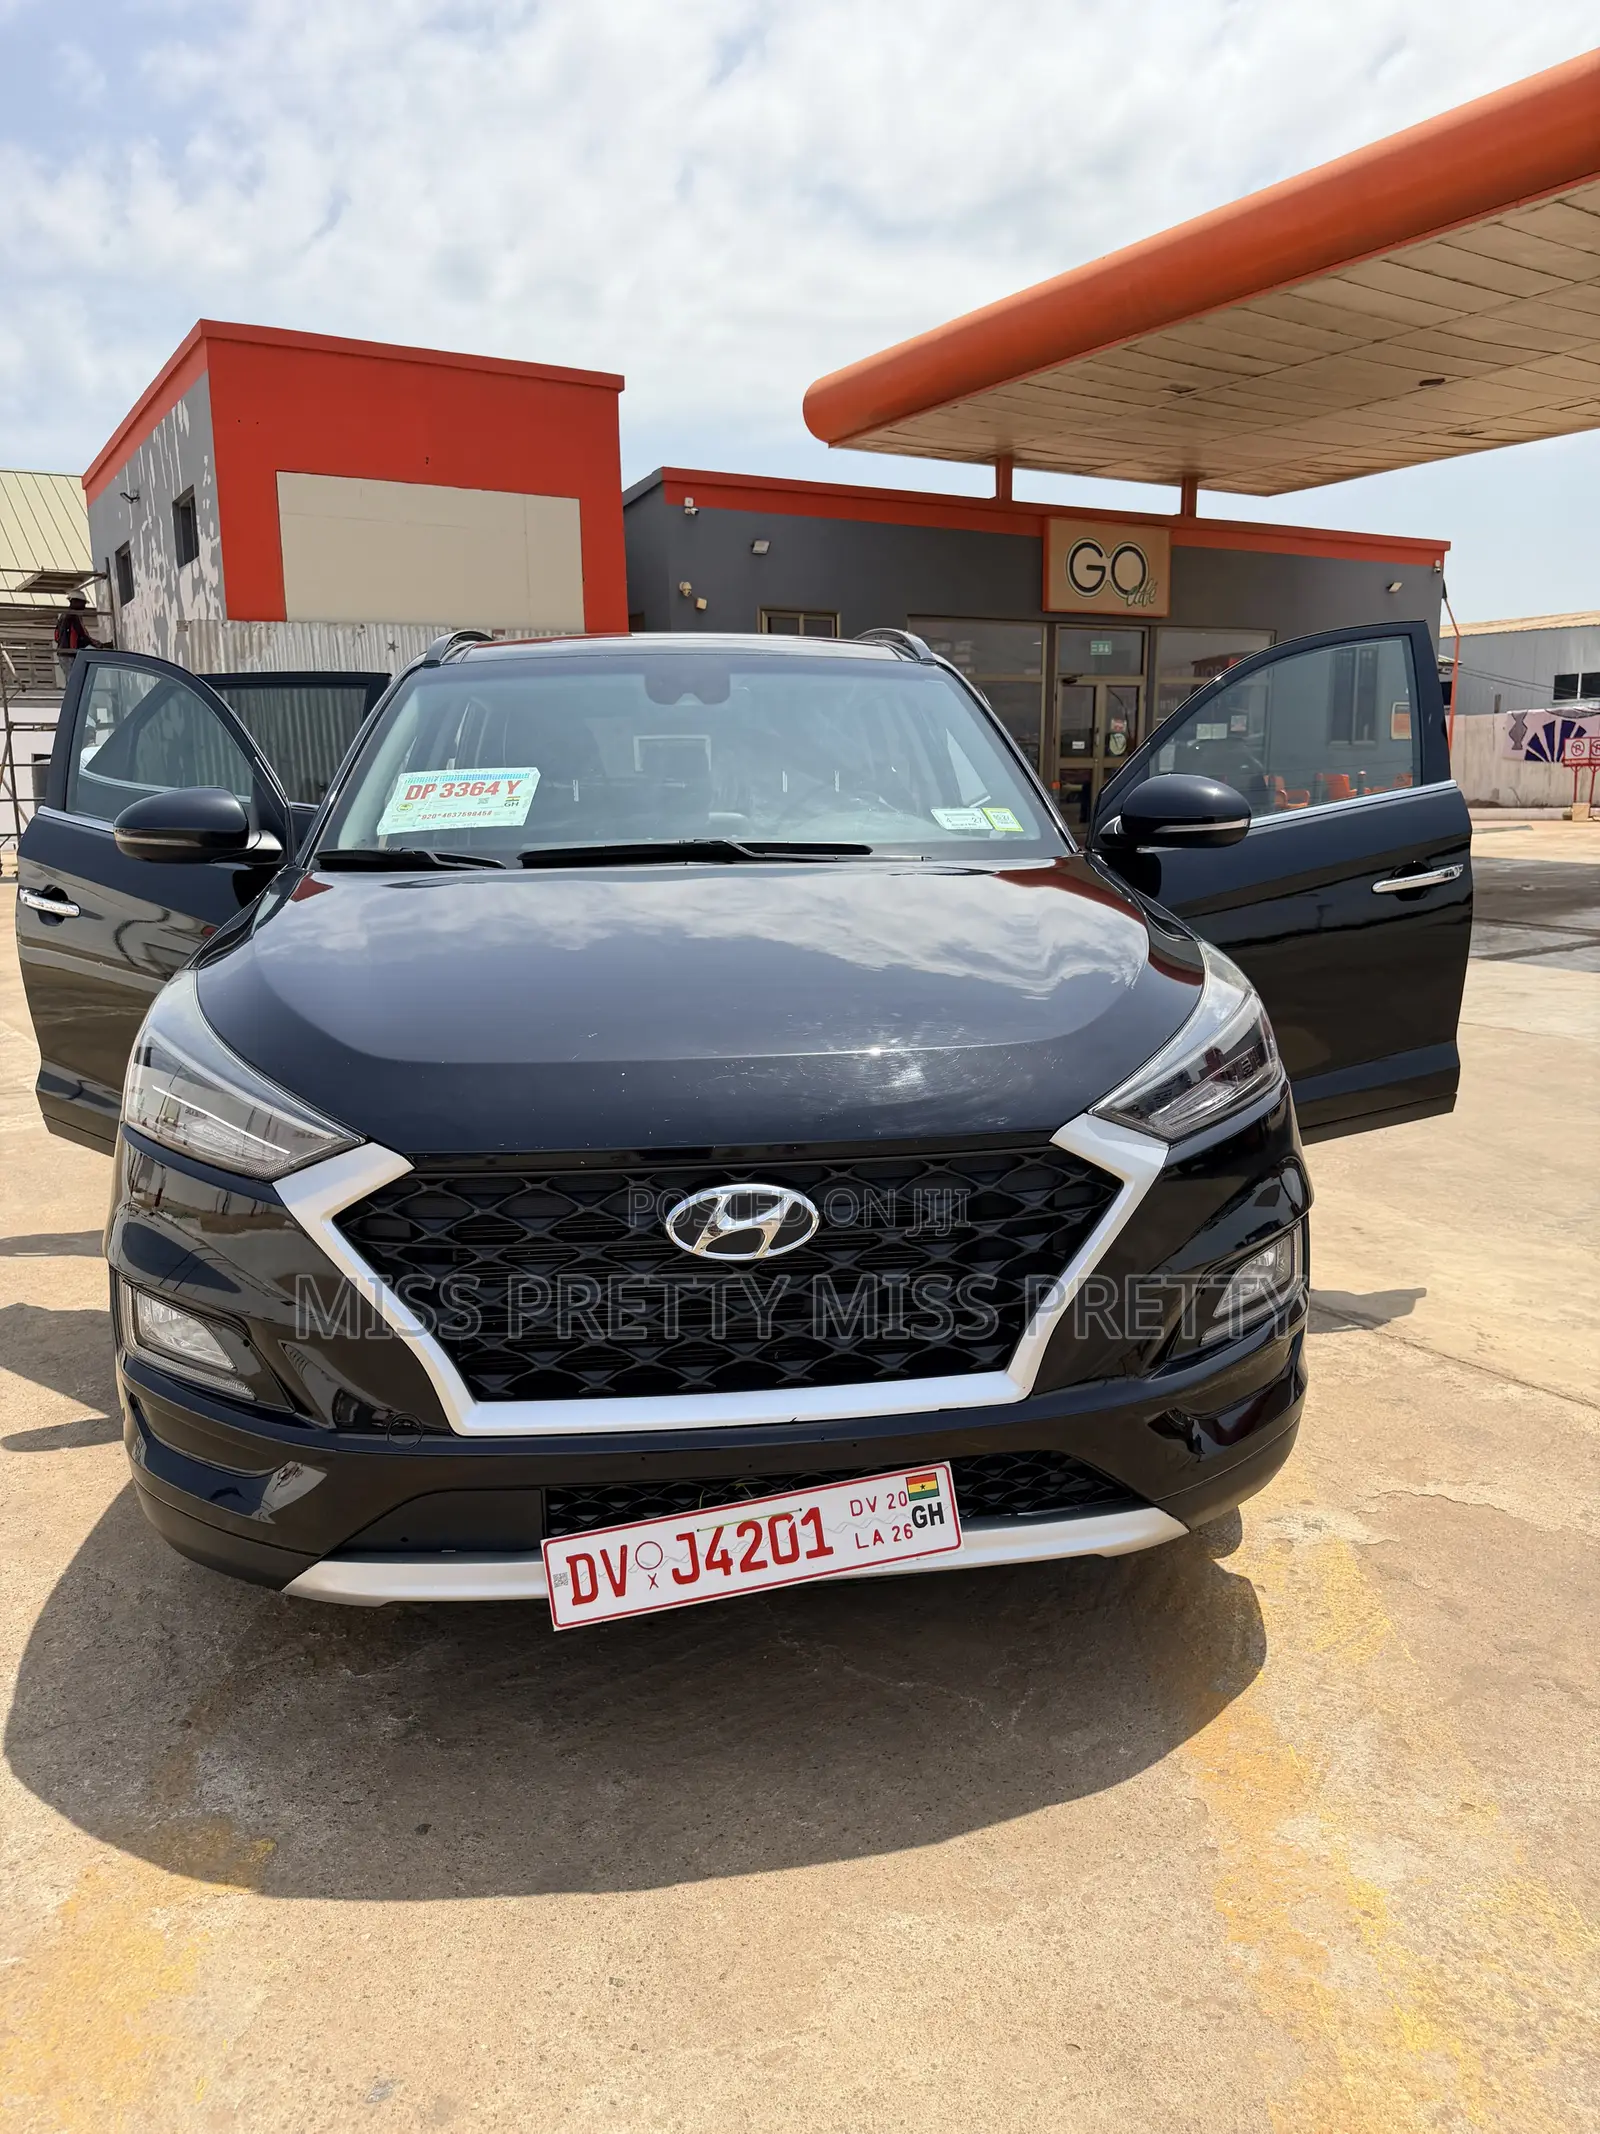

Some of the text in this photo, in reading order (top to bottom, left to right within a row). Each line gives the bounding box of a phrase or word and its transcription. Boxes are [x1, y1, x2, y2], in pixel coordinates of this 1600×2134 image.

[1066, 538, 1148, 597] GO
[404, 779, 524, 801] DP 3364 Y
[849, 1489, 908, 1518] DV 20
[911, 1501, 945, 1529] GH
[854, 1522, 914, 1550] LA 26
[566, 1506, 834, 1606] DV J4201
